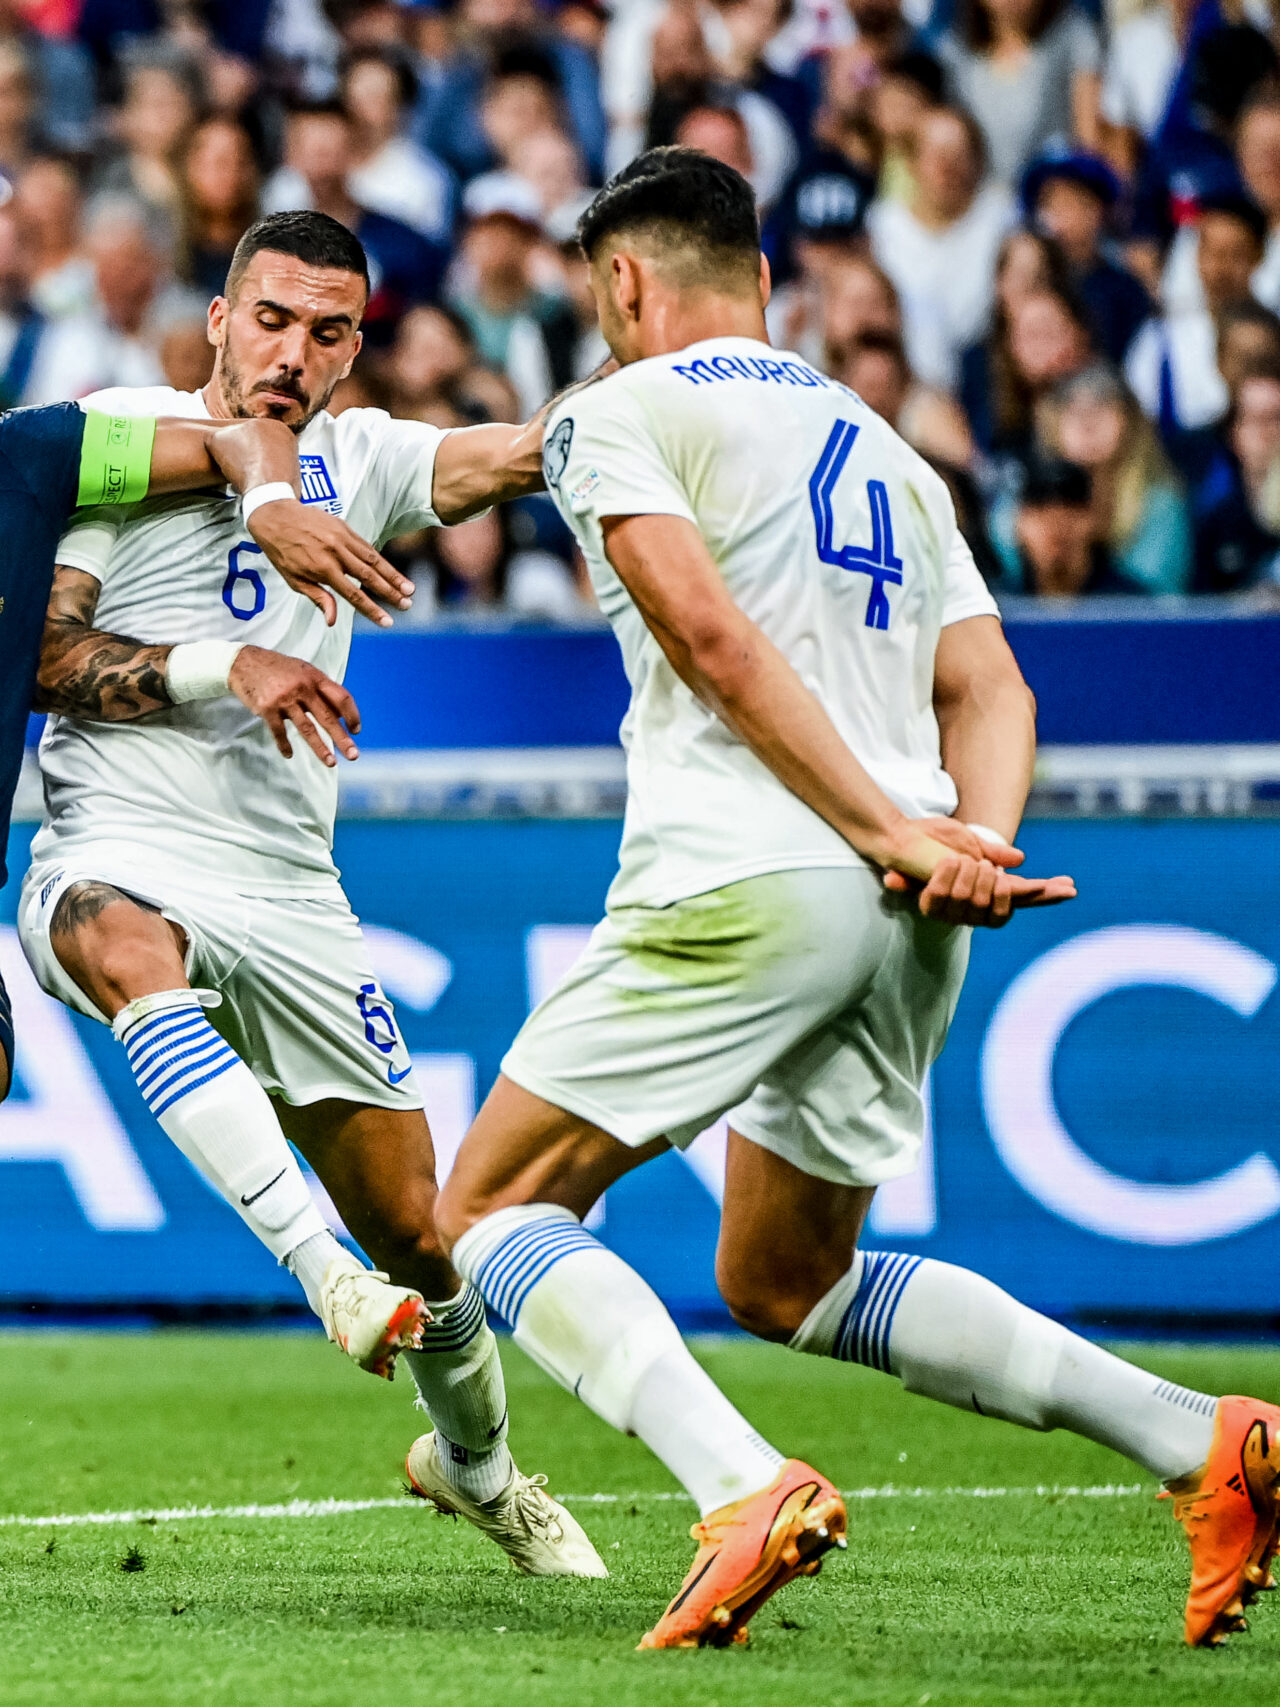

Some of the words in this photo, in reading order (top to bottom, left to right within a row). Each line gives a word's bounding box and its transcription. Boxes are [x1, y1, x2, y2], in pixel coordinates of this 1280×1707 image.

[809, 418, 902, 630] 4
[222, 541, 266, 621] 6
[356, 983, 398, 1053] 6
